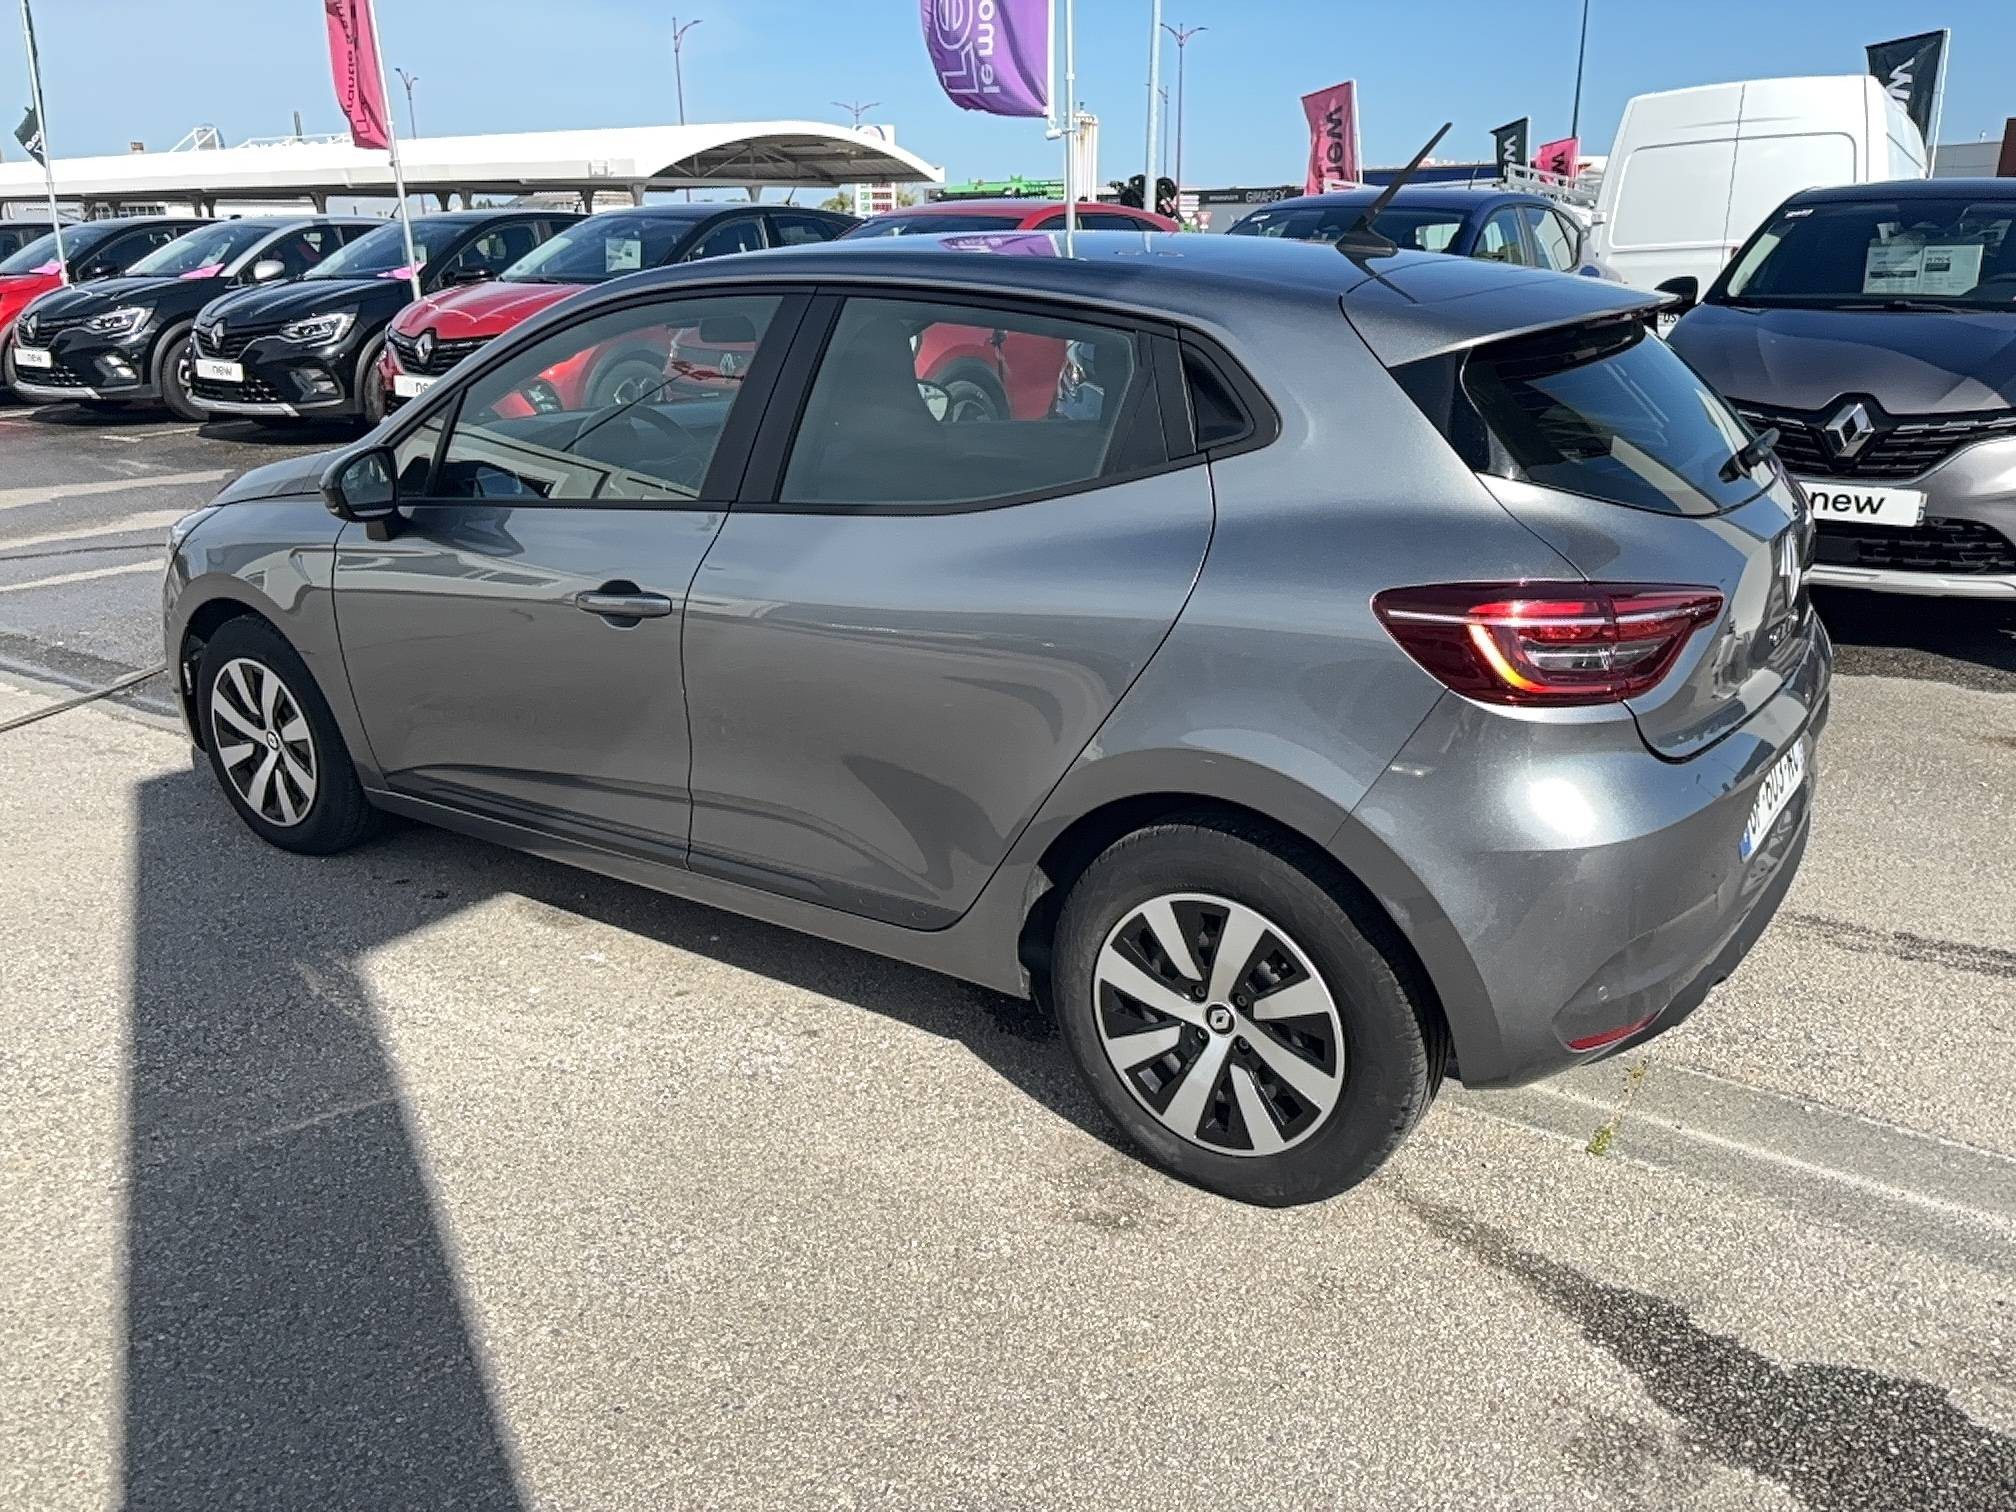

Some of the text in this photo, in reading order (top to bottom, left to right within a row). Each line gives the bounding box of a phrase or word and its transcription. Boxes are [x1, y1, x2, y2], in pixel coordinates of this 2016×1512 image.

[212, 365, 233, 377] new
[415, 382, 432, 393] ne
[1810, 491, 1886, 515] new
